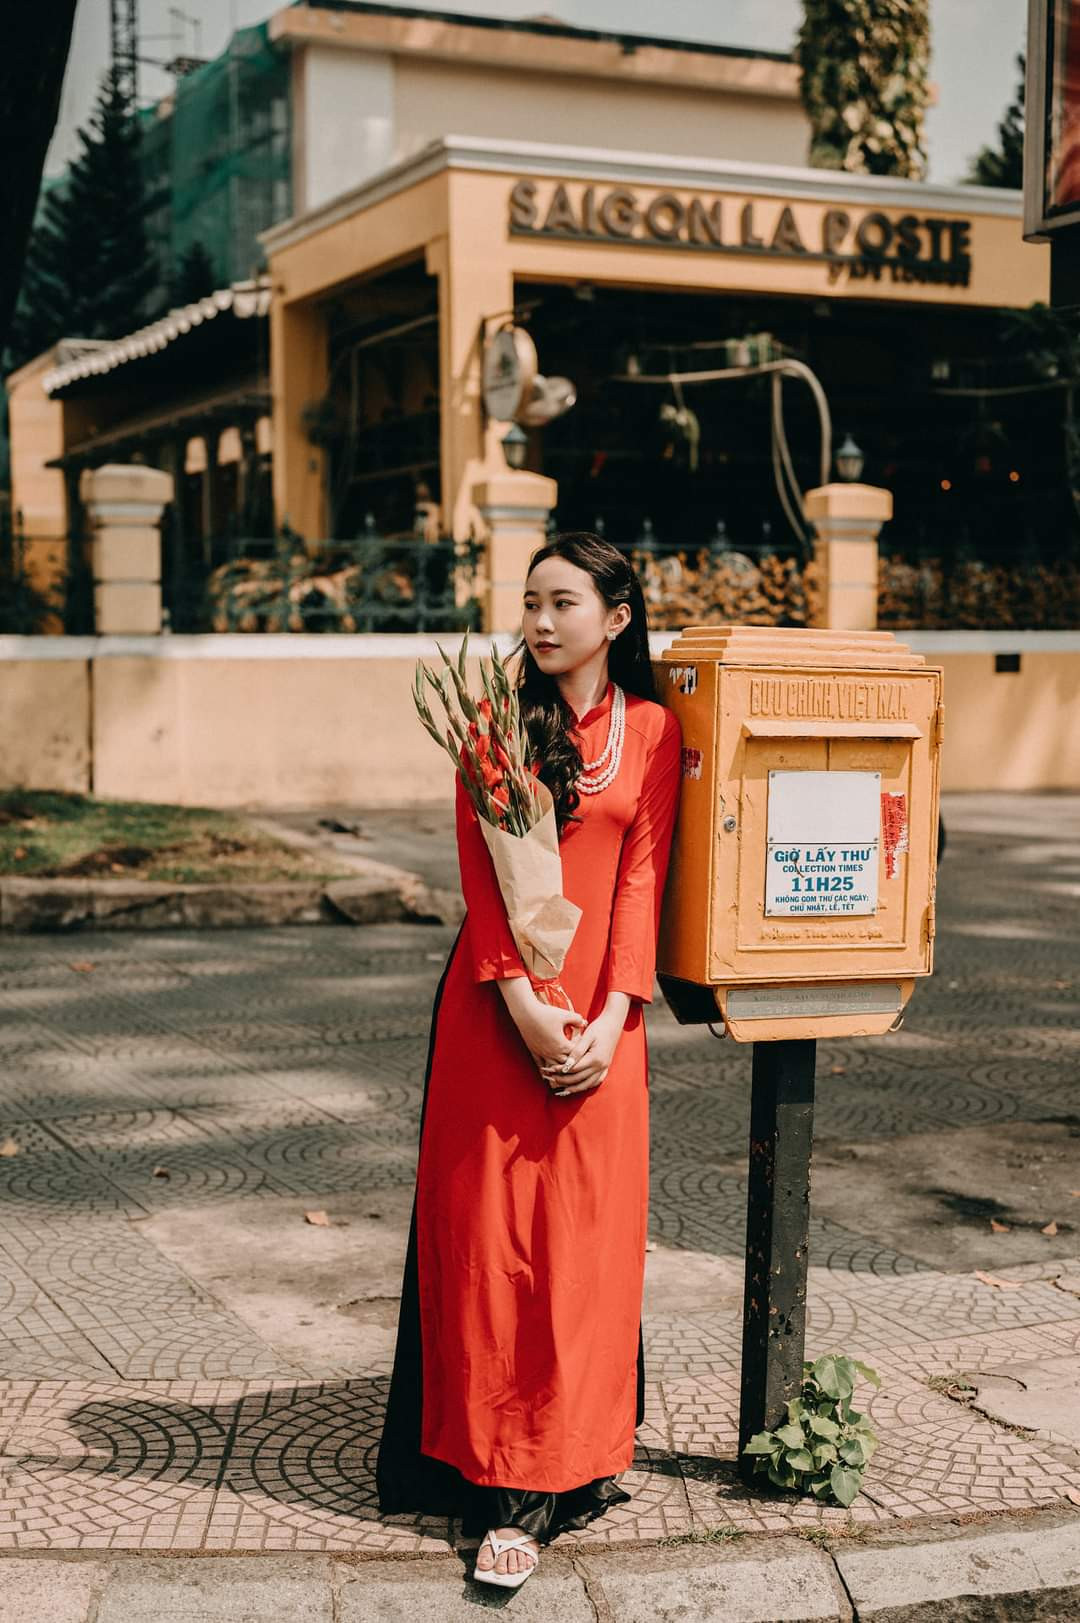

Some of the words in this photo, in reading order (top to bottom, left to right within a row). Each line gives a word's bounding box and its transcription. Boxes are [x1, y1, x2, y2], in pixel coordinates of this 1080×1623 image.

[509, 179, 723, 247] SAIGON
[741, 201, 805, 254] LA
[822, 210, 971, 264] POSTE
[805, 846, 836, 862] LẤY
[841, 847, 872, 862] THƯ
[783, 865, 836, 873] COLLECTION
[838, 864, 864, 872] TIMES
[791, 876, 854, 892] 11H25
[775, 894, 800, 903] KHÔNG
[801, 895, 817, 903] GOM
[834, 894, 849, 902] CÁC
[790, 904, 804, 912] CHỦ
[842, 903, 855, 911] TẾT
